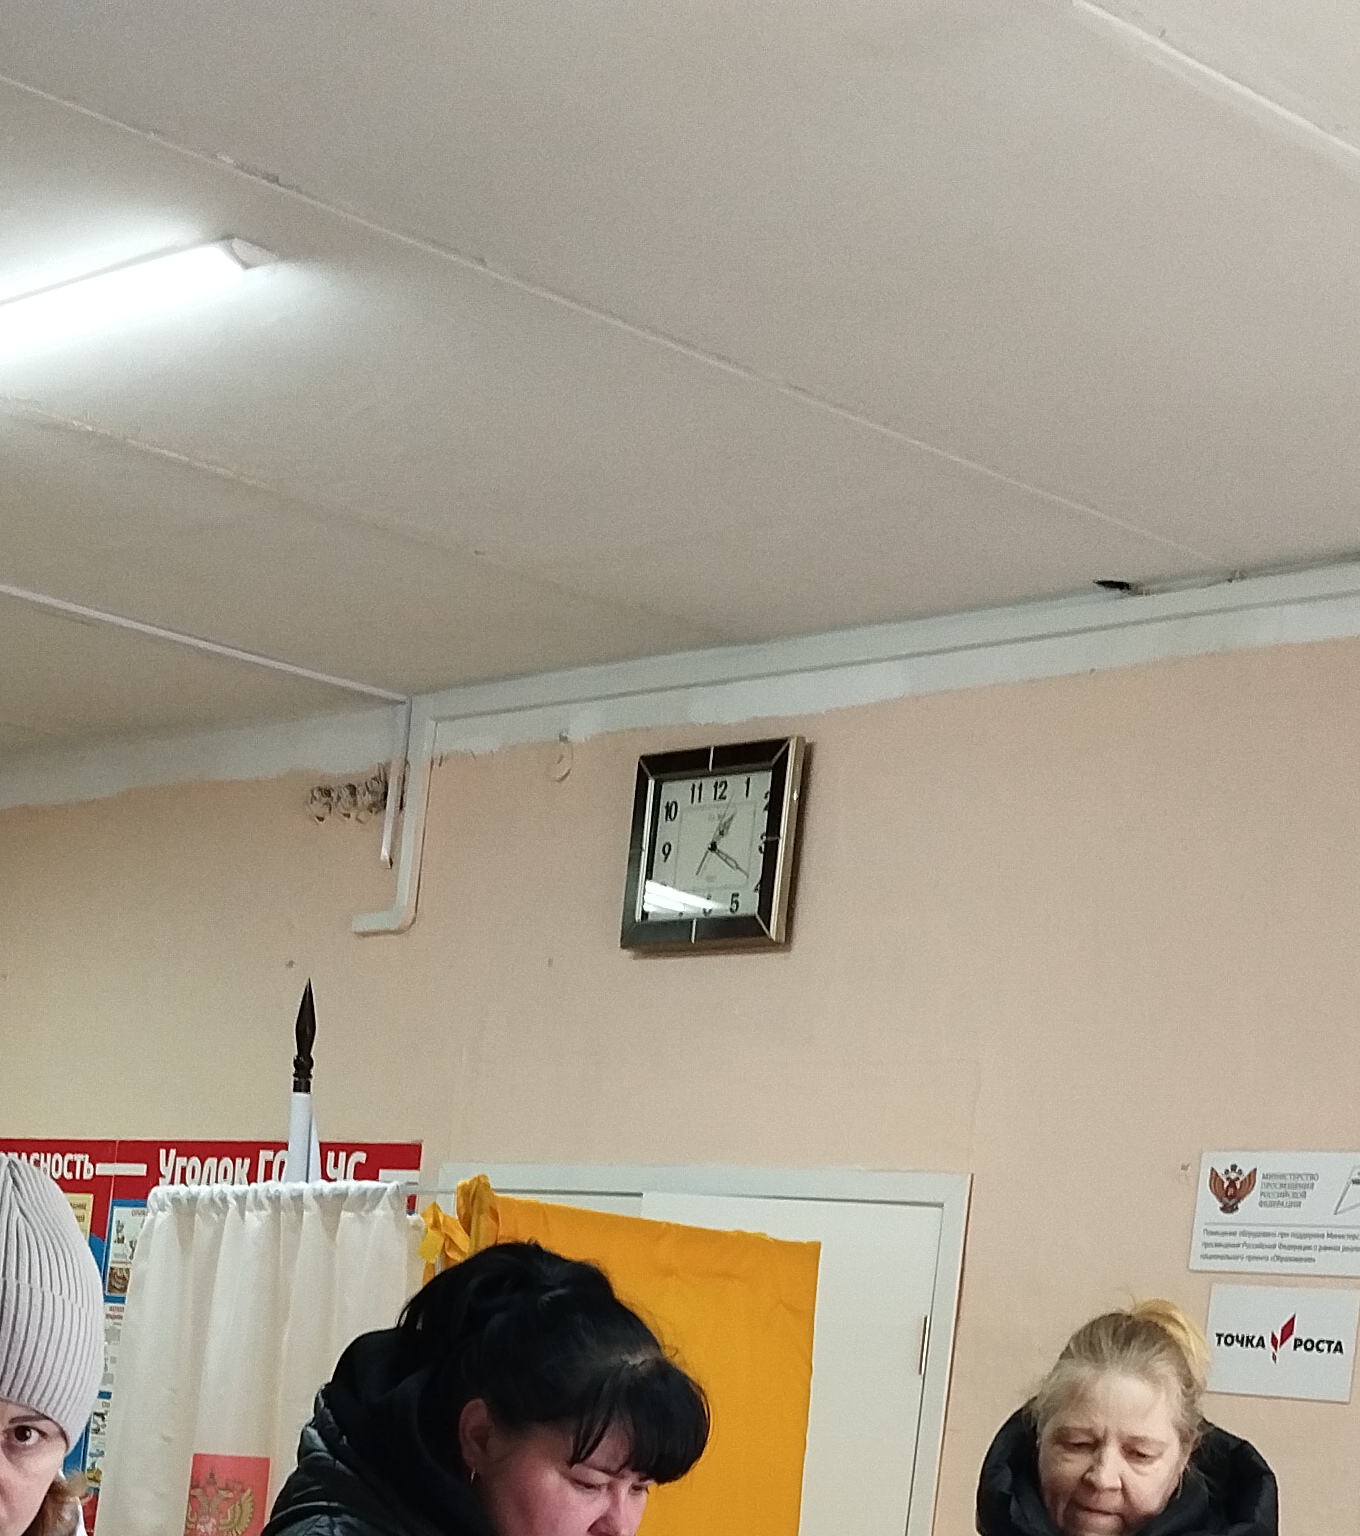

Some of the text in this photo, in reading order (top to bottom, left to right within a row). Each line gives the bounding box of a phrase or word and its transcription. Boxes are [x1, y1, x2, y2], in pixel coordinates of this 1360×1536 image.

[691, 781, 703, 805] 11
[713, 780, 728, 801] 12
[744, 777, 751, 798] 1
[665, 800, 678, 823] 10
[662, 841, 672, 862] 9
[729, 892, 740, 914] 5
[159, 1148, 251, 1186] Уголок
[326, 1150, 367, 1182] ЧС
[1215, 1332, 1344, 1355] ТОЧКА РОСТА
